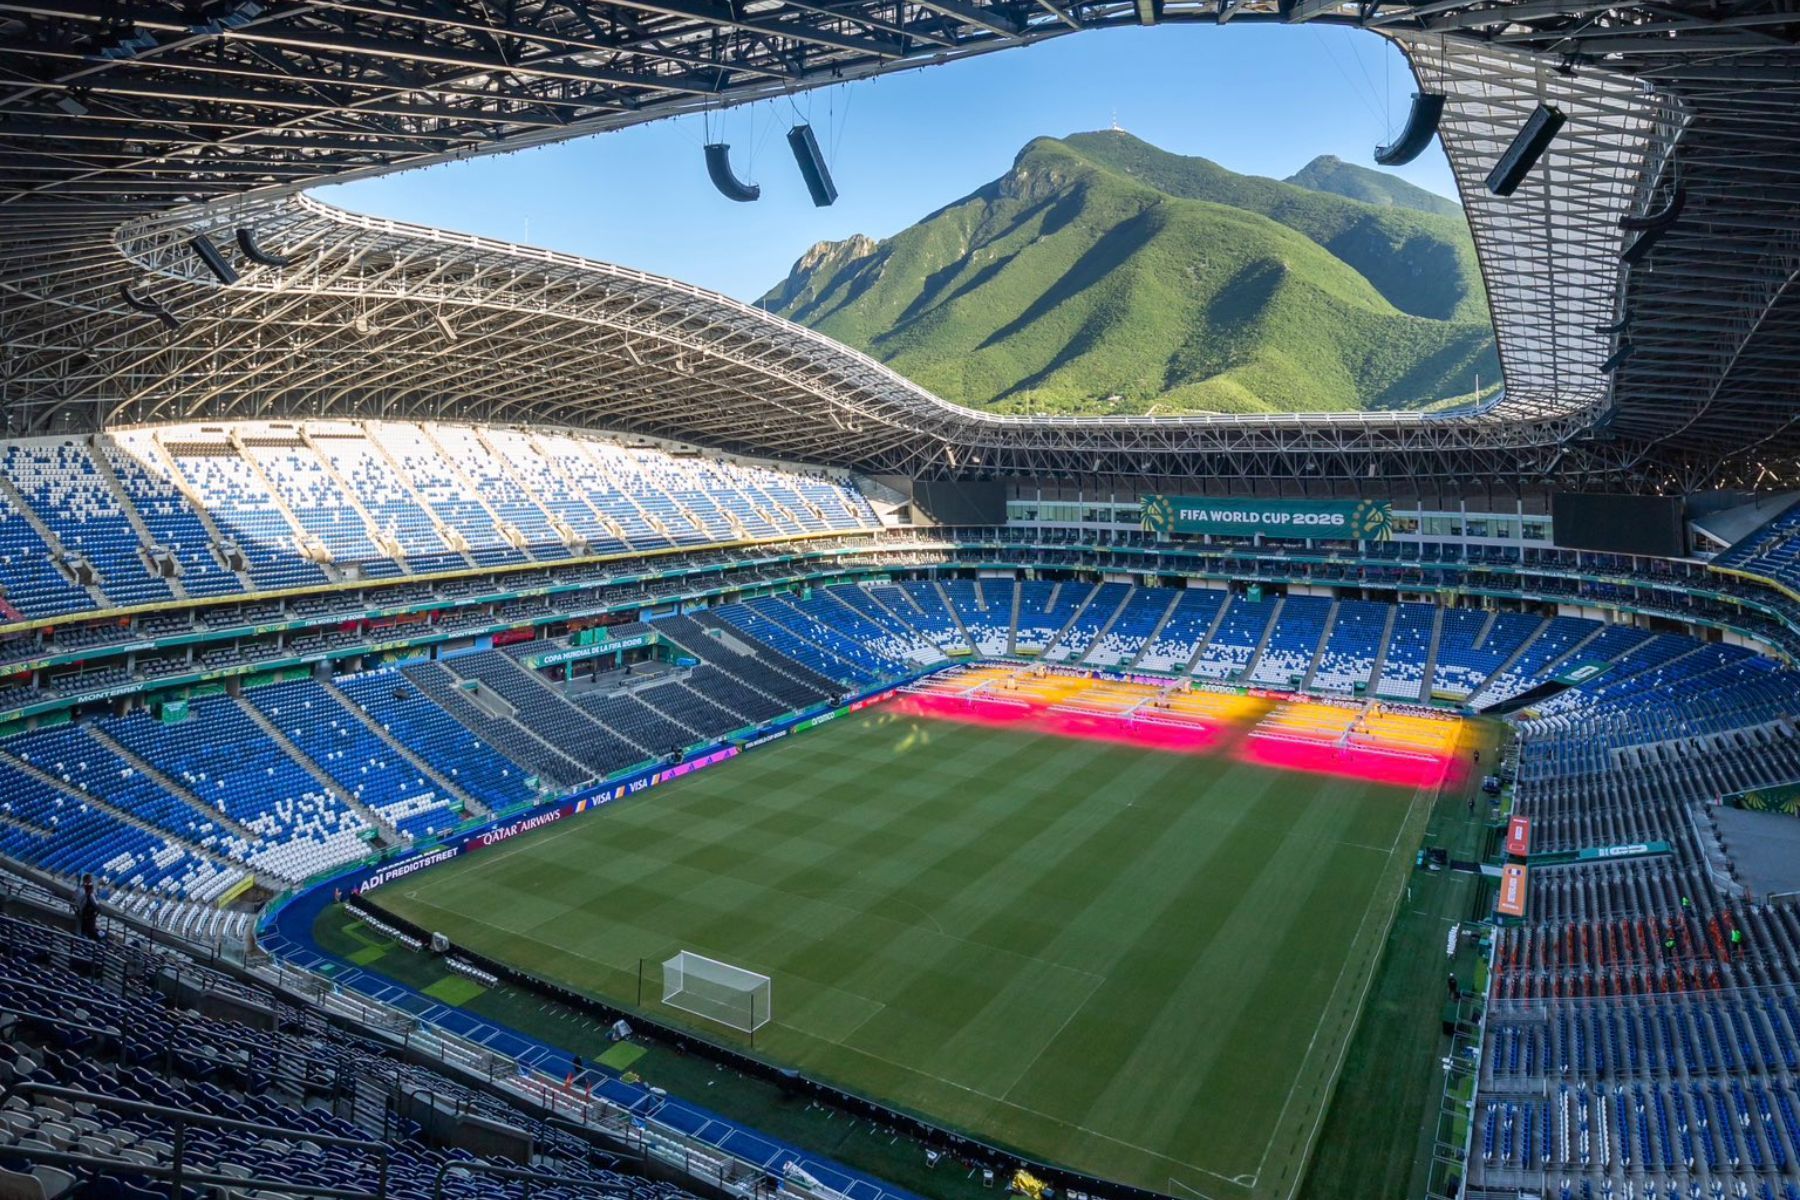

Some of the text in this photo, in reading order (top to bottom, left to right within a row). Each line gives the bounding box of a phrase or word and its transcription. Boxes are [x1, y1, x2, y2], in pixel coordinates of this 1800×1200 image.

[1180, 509, 1345, 525] FIFA WORLD CUP 2026
[544, 637, 642, 664] COPA MUNDIAL DE LA FIFA 2026
[77, 684, 144, 704] MONTERREY
[1201, 684, 1236, 694] aramco
[629, 778, 648, 792] VISA
[592, 791, 611, 806] VISA
[483, 808, 561, 845] QATAR AIRWAYS
[360, 849, 457, 893] ADI PREDICTSTREET
